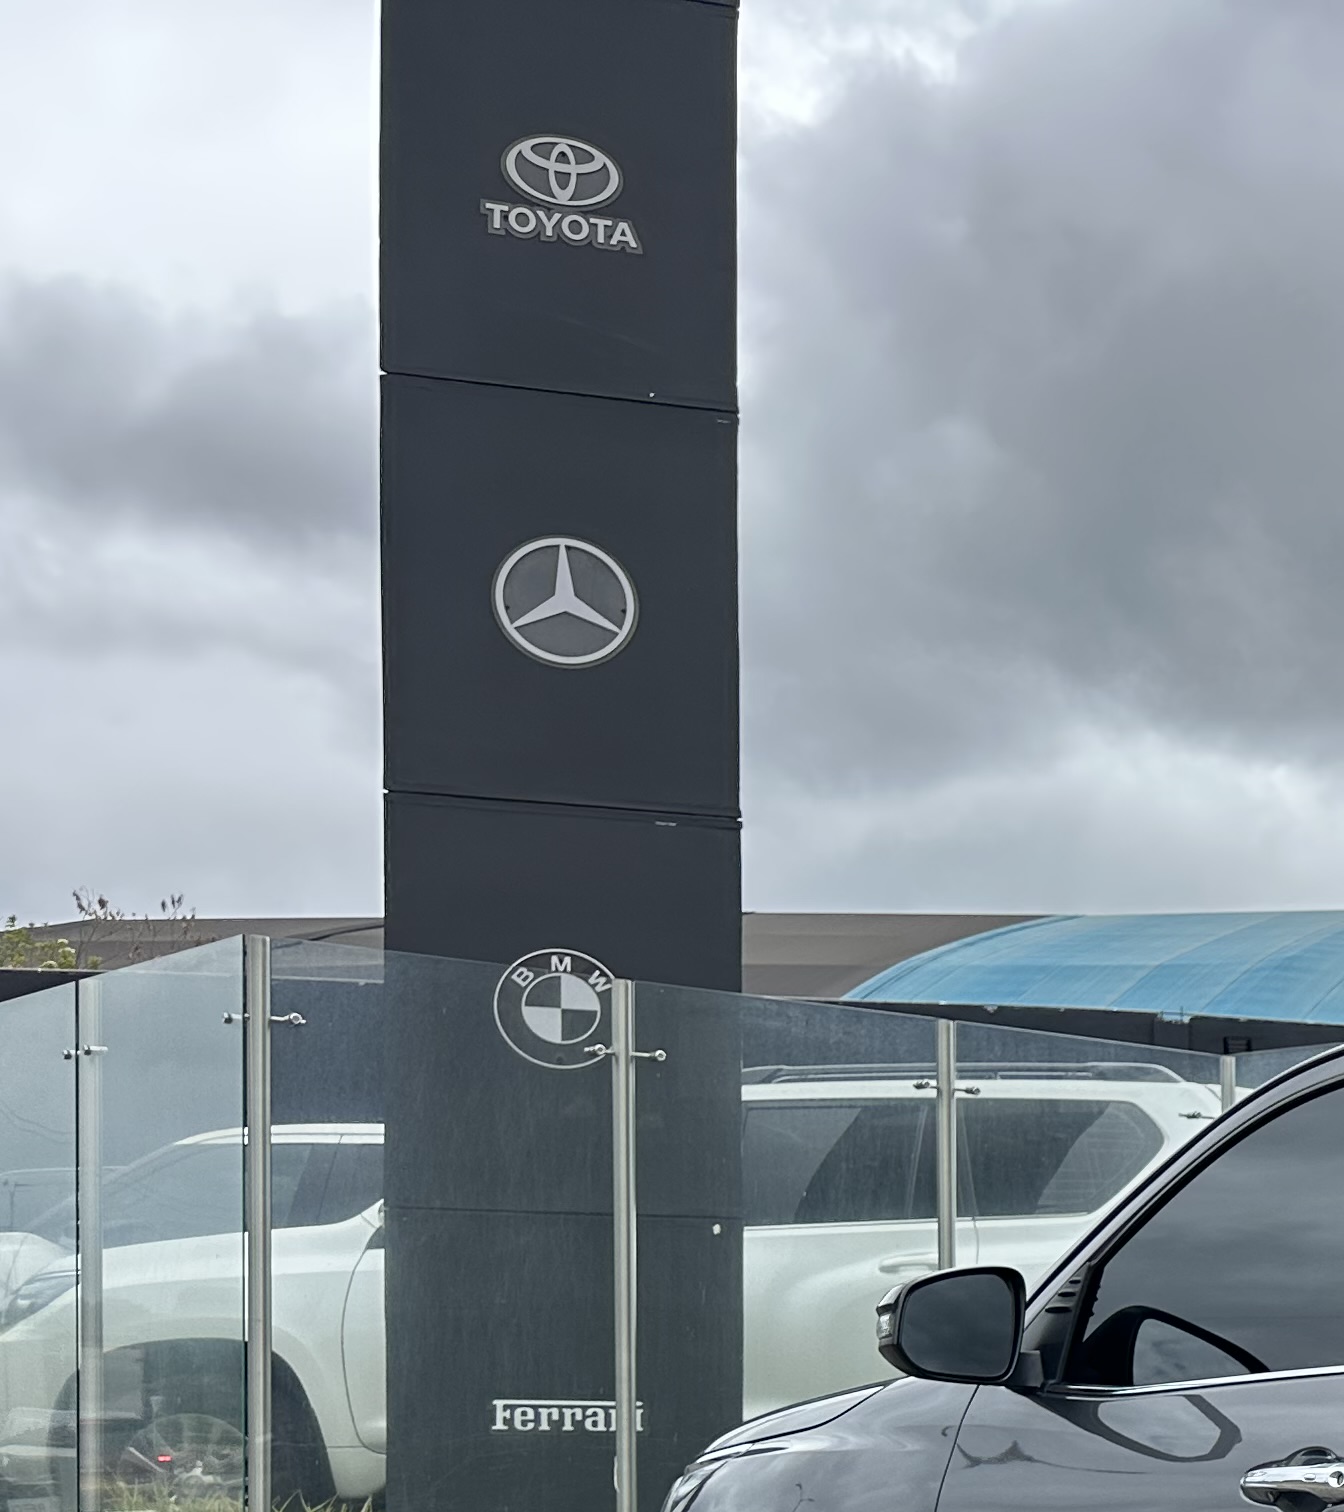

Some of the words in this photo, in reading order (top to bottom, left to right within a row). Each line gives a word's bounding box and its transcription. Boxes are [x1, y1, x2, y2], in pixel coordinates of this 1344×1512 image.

[484, 202, 638, 249] TOYOTA
[511, 955, 613, 989] BMW
[491, 1399, 645, 1432] Ferrai
